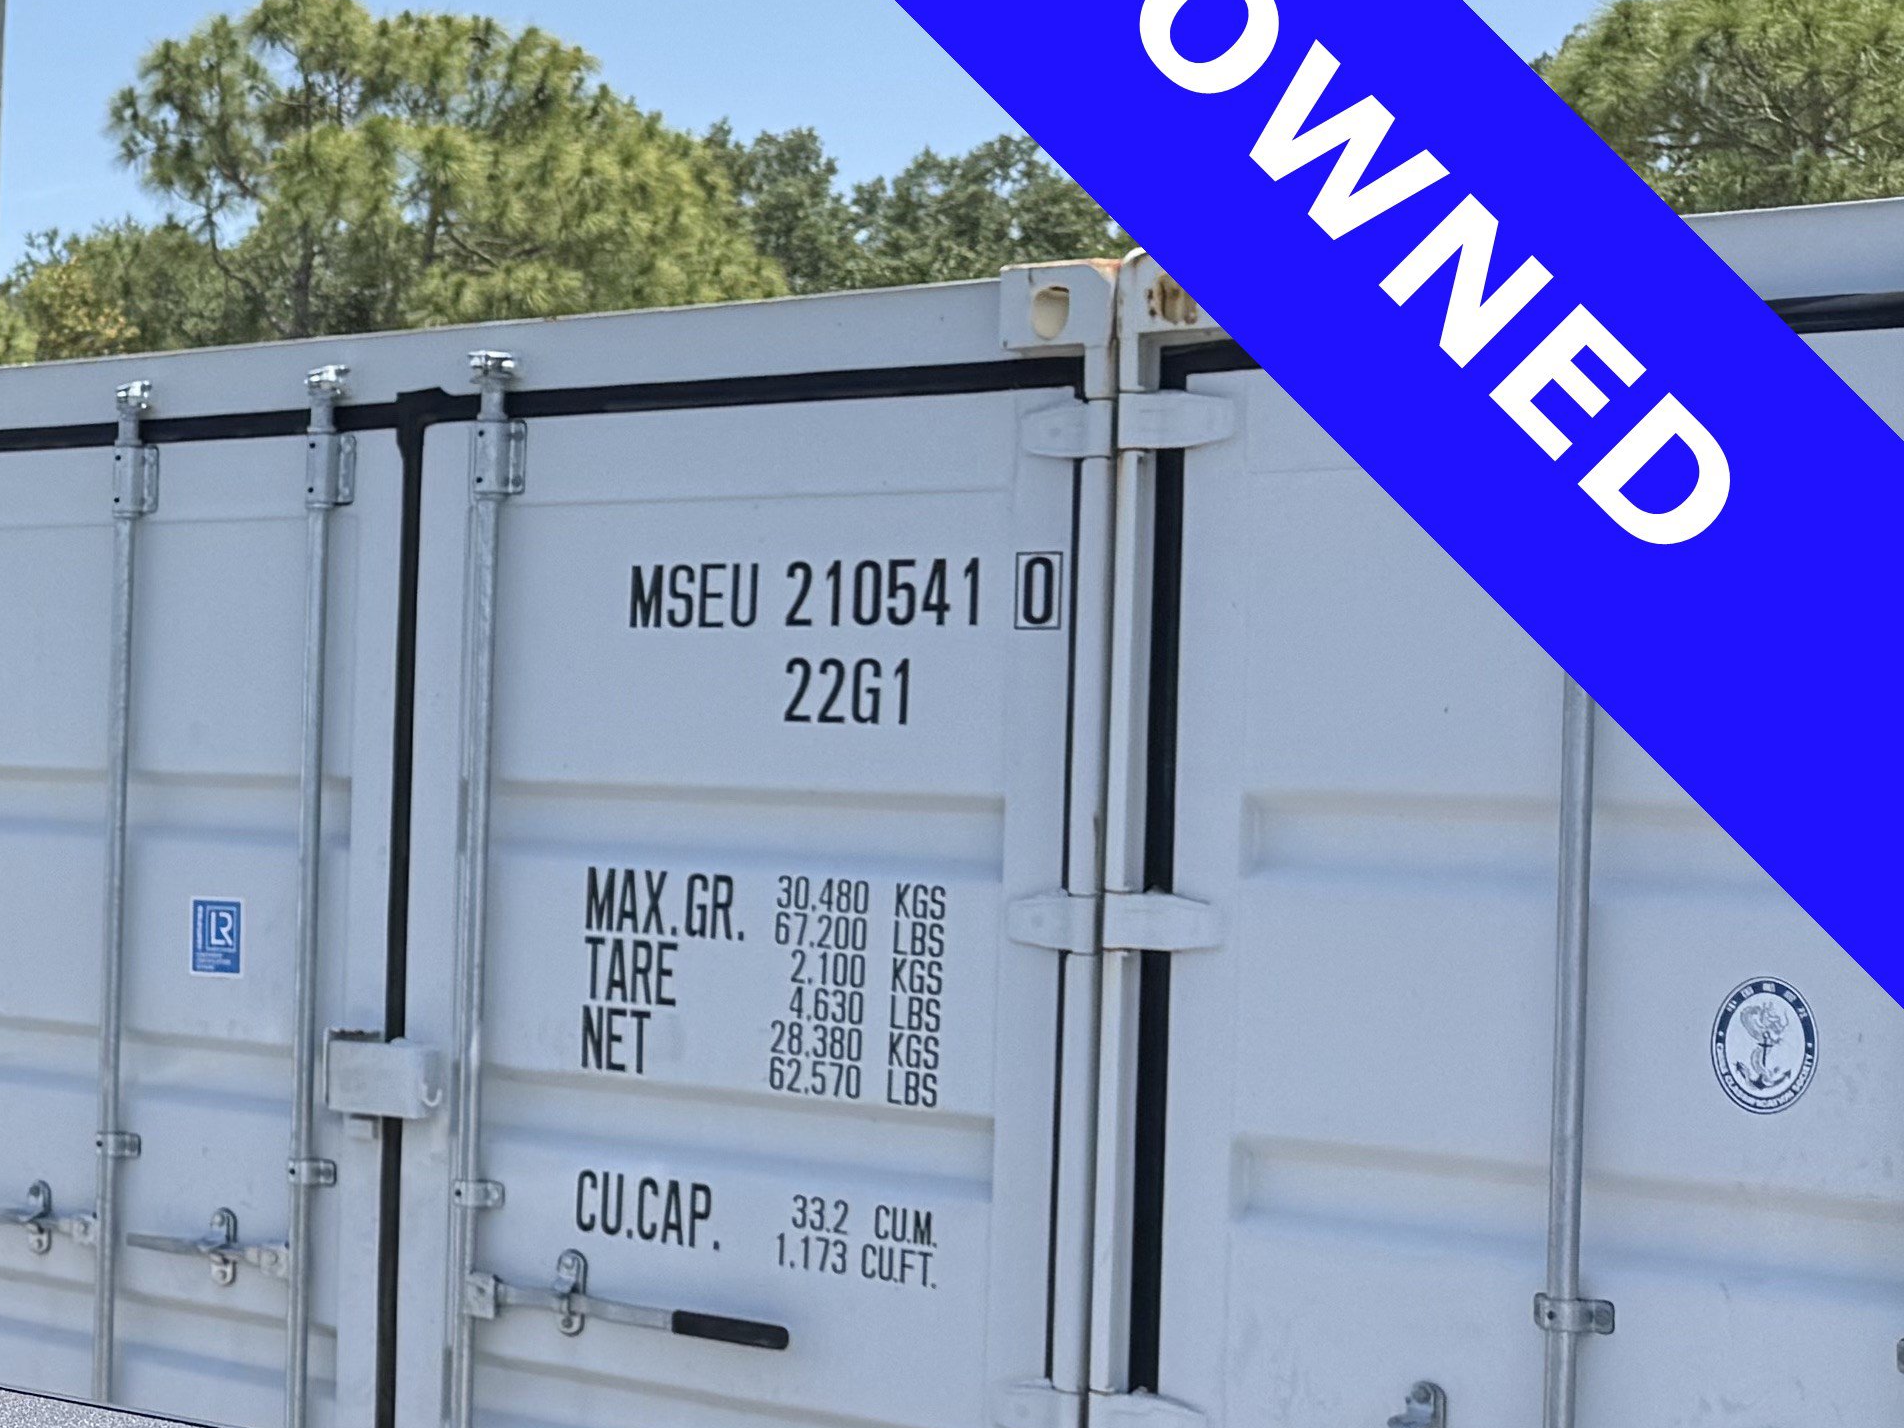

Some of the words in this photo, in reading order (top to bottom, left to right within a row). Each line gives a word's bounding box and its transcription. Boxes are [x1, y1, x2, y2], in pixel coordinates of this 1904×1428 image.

[629, 562, 759, 628] MSEU
[784, 556, 980, 627] 210541
[784, 656, 911, 726] 22G1
[776, 875, 870, 915] 30.480
[894, 882, 947, 921] KGS
[774, 912, 868, 952] 67.200
[893, 920, 945, 958] LBS
[584, 936, 679, 1008] TARE
[790, 950, 866, 988] 2.100
[891, 957, 944, 996] KGS
[789, 986, 864, 1026] 4.630
[890, 994, 942, 1034] LBS
[581, 1005, 652, 1075] NET
[770, 1020, 863, 1062] 28.380
[888, 1032, 940, 1071] KGS
[768, 1056, 861, 1100] 62.570
[886, 1068, 938, 1108] LBS
[792, 1194, 849, 1236] 33.2
[874, 1204, 938, 1250] CU.M.
[775, 1232, 848, 1276] 1.173
[860, 1243, 938, 1290] CU.FT.
